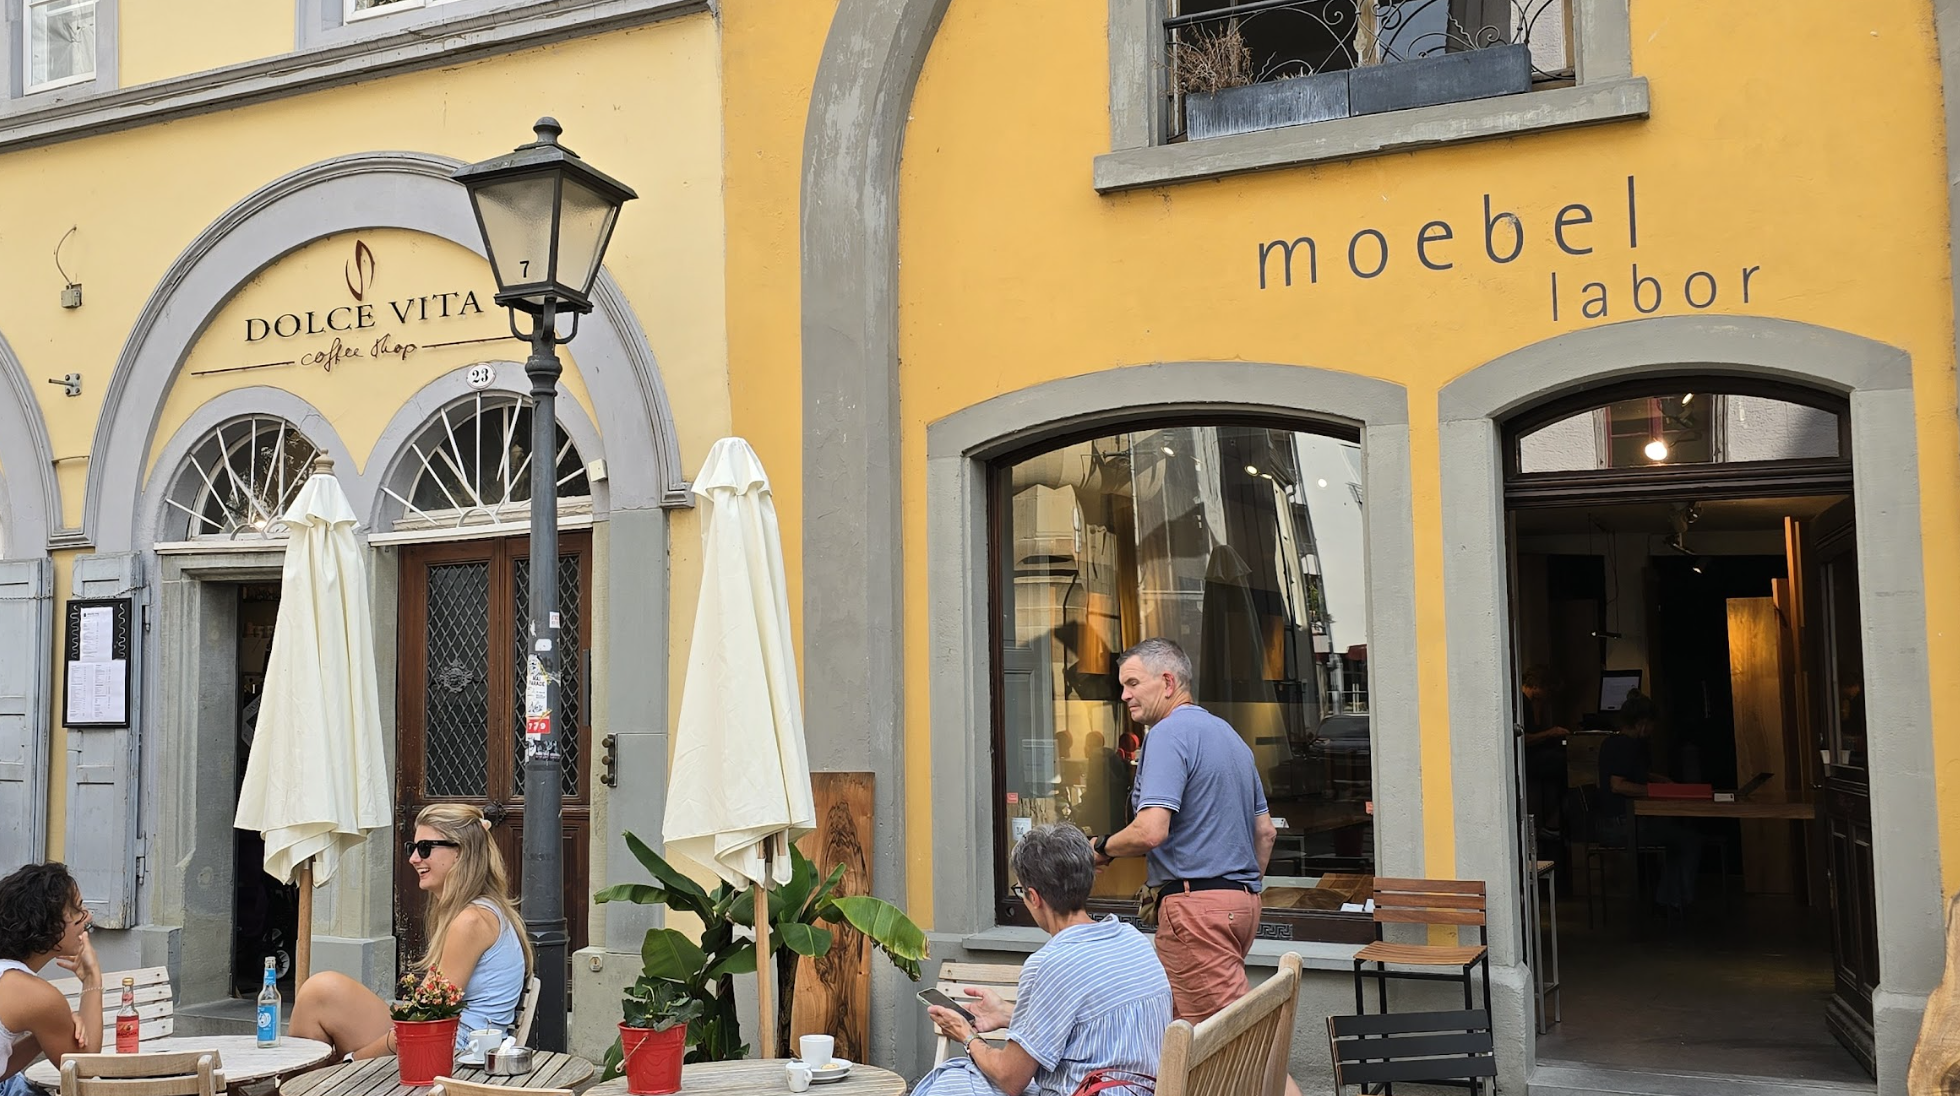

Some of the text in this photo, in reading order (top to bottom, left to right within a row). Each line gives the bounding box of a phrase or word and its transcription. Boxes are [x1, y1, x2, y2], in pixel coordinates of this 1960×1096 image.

[1258, 175, 1637, 290] moebel
[519, 260, 530, 279] 7
[1551, 263, 1760, 322] labor
[244, 290, 484, 342] DOLCE VITA
[300, 337, 364, 373] coffee
[471, 367, 489, 384] 23
